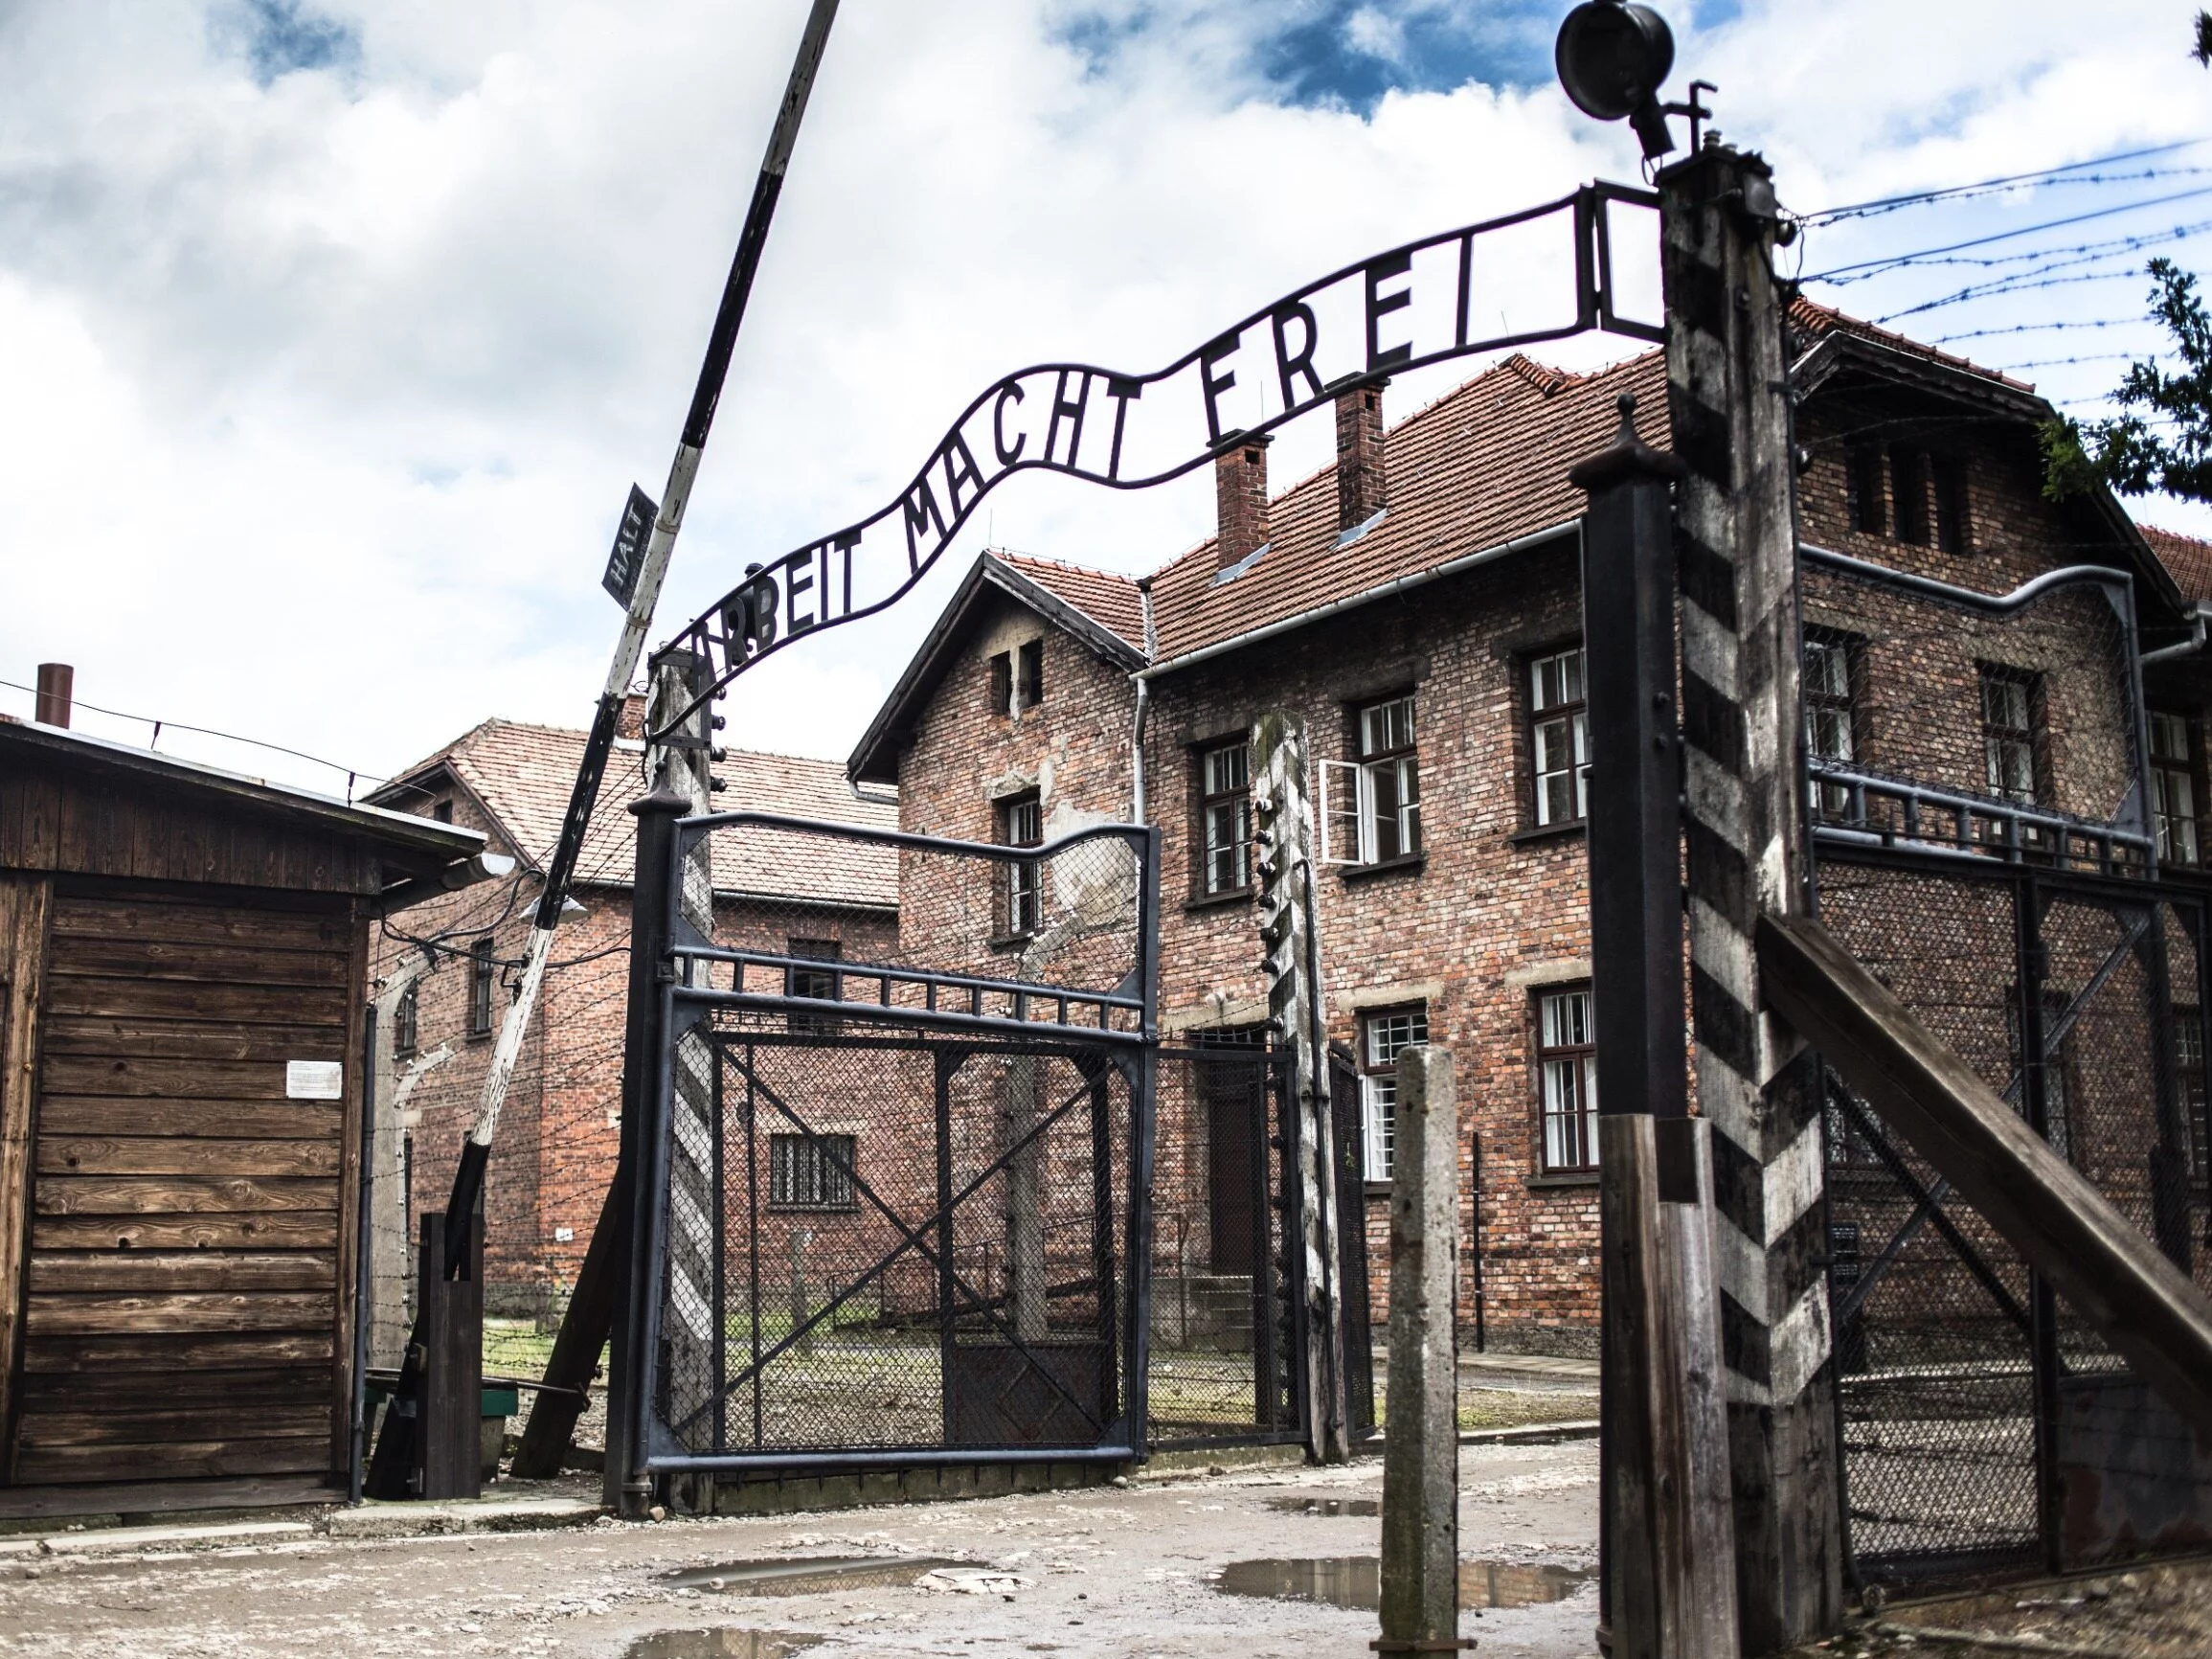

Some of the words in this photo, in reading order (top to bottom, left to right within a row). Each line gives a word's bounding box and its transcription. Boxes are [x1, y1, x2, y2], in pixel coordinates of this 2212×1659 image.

[609, 502, 643, 586] HALT
[690, 531, 862, 701] ARBEIT
[902, 369, 1143, 575] MACHT
[1201, 233, 1474, 445] FREI
